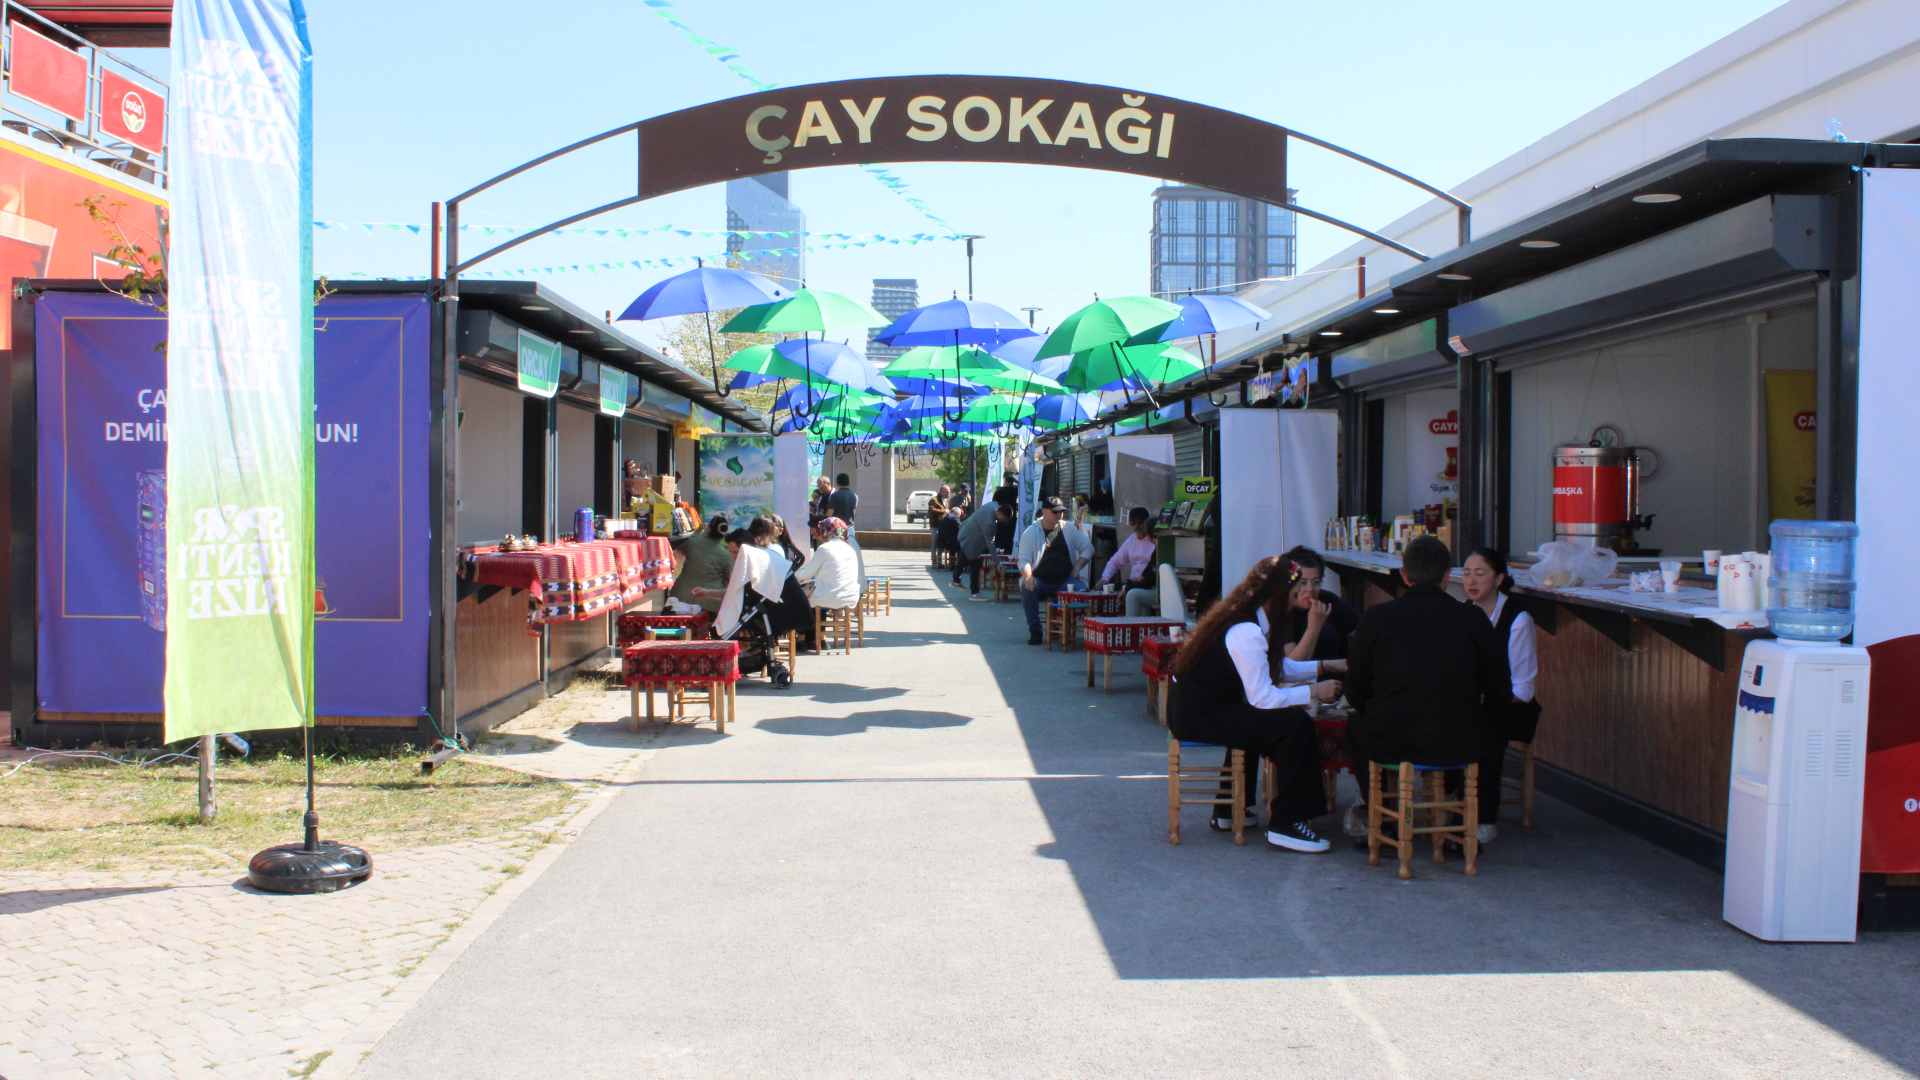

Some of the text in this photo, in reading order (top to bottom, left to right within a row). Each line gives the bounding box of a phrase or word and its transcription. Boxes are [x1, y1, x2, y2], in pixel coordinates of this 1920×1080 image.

[125, 99, 143, 116] DOĞUŞ
[745, 93, 1175, 165] ÇAY SOKAĞI
[138, 388, 167, 413] ÇA
[1797, 415, 1816, 428] ÇA
[315, 423, 358, 442] UN!
[708, 477, 764, 489] VEGAÇAY
[1186, 485, 1210, 493] OFÇAY
